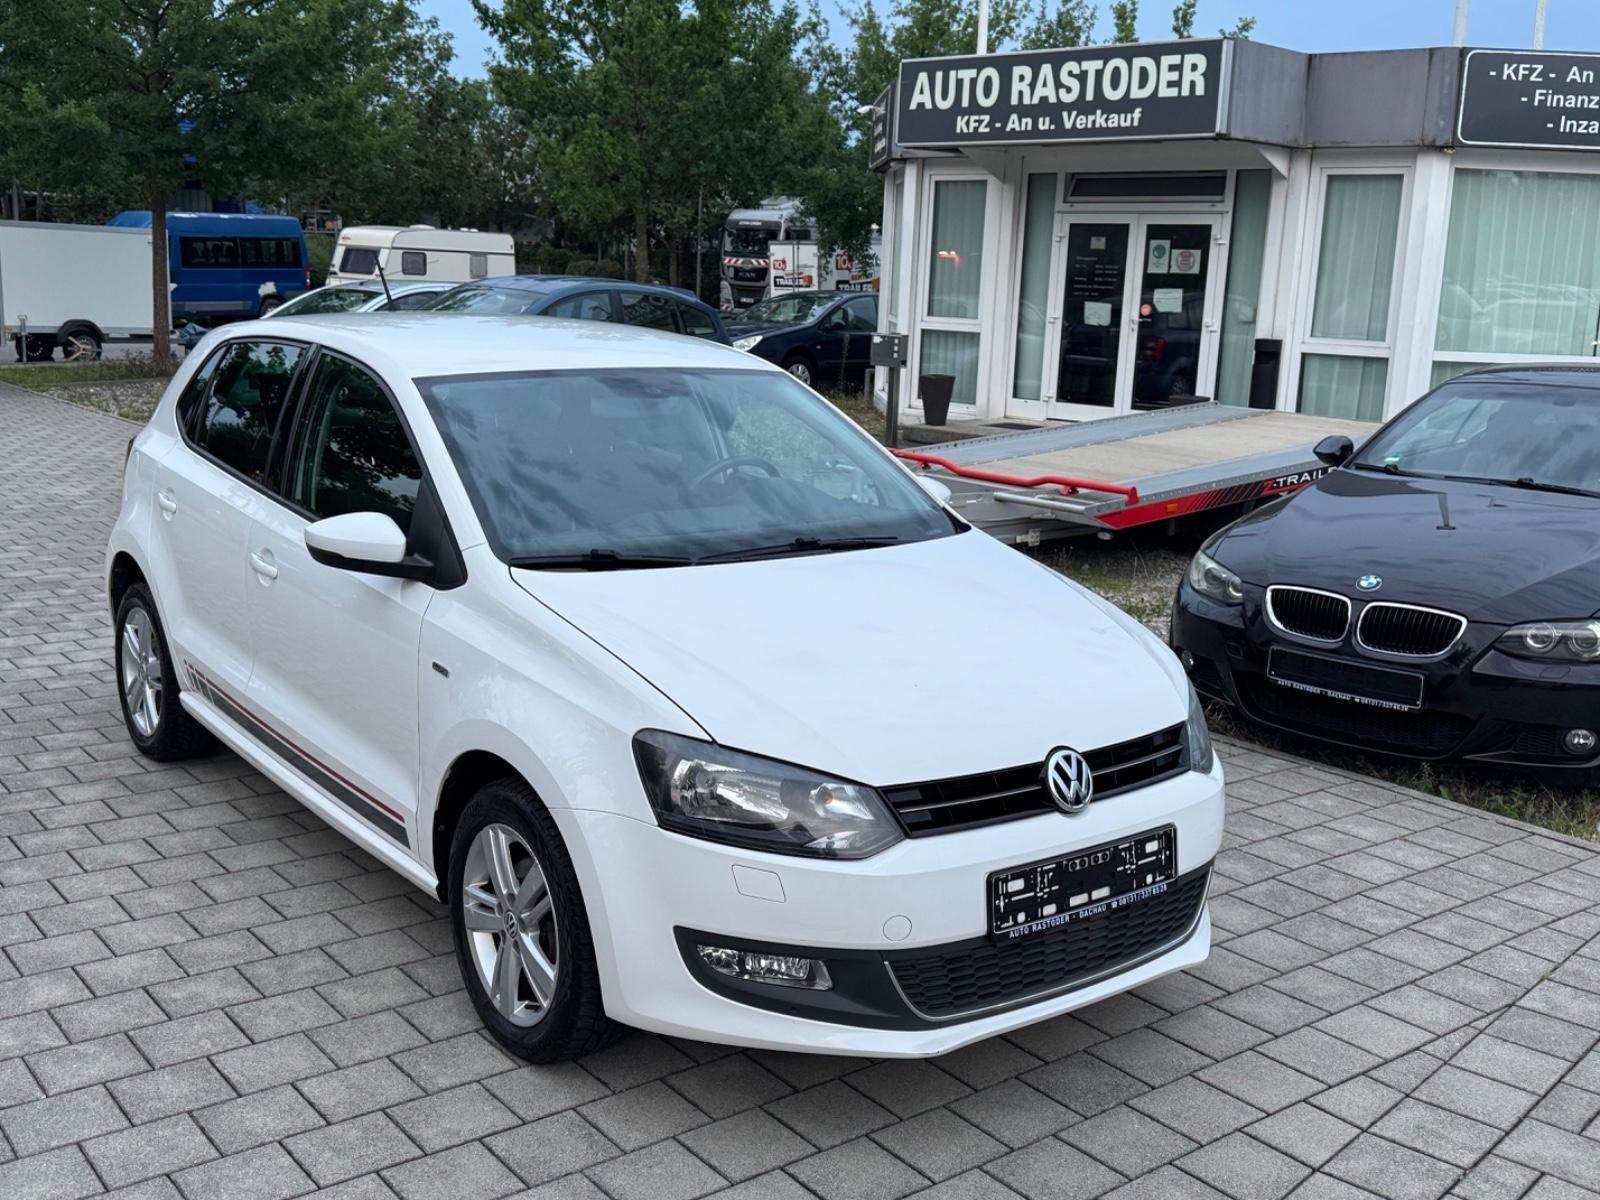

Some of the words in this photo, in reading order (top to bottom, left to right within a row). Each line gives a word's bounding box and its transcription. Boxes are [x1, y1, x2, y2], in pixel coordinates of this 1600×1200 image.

[909, 67, 1000, 111] AUTO
[1010, 53, 1208, 106] RASTODER
[1502, 63, 1544, 82] KFZ
[1566, 66, 1594, 84] An
[1534, 89, 1600, 109] Finanz
[955, 114, 991, 134] KFZ
[1005, 113, 1033, 133] An
[1038, 116, 1056, 132] u.
[1062, 107, 1143, 130] Verkauf
[1559, 115, 1600, 134] Inza
[1008, 926, 1030, 939] AUTO
[1032, 914, 1070, 933] RASTODER
[1079, 903, 1107, 919] DACHAU
